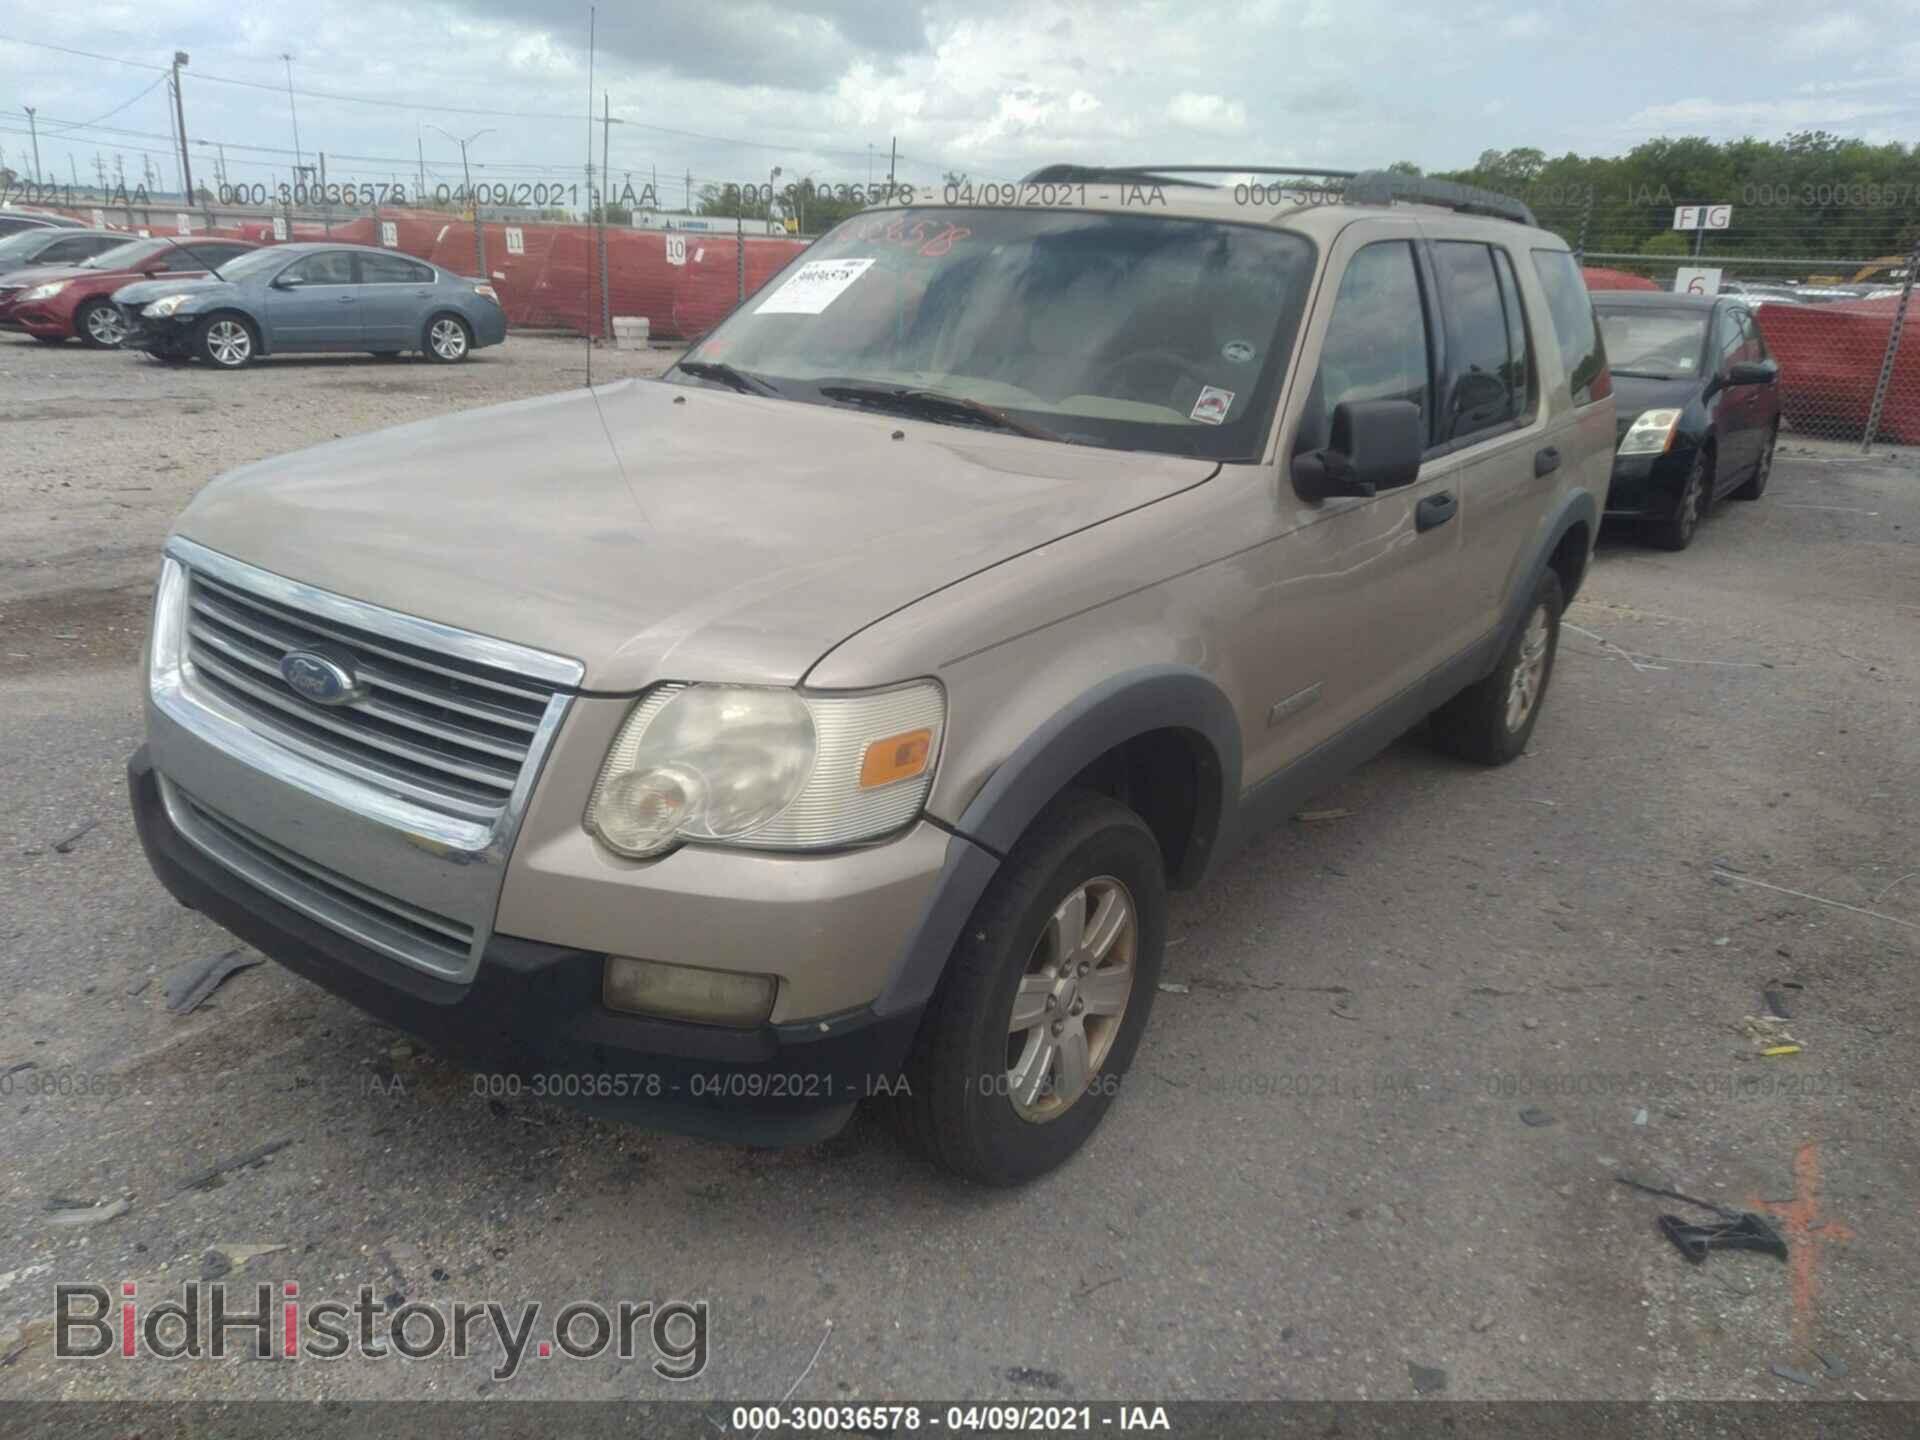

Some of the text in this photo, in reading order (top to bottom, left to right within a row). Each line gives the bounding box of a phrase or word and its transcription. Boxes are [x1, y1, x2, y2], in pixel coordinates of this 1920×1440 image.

[1679, 211, 1728, 228] F G
[508, 232, 522, 250] 11
[667, 239, 685, 259] 10
